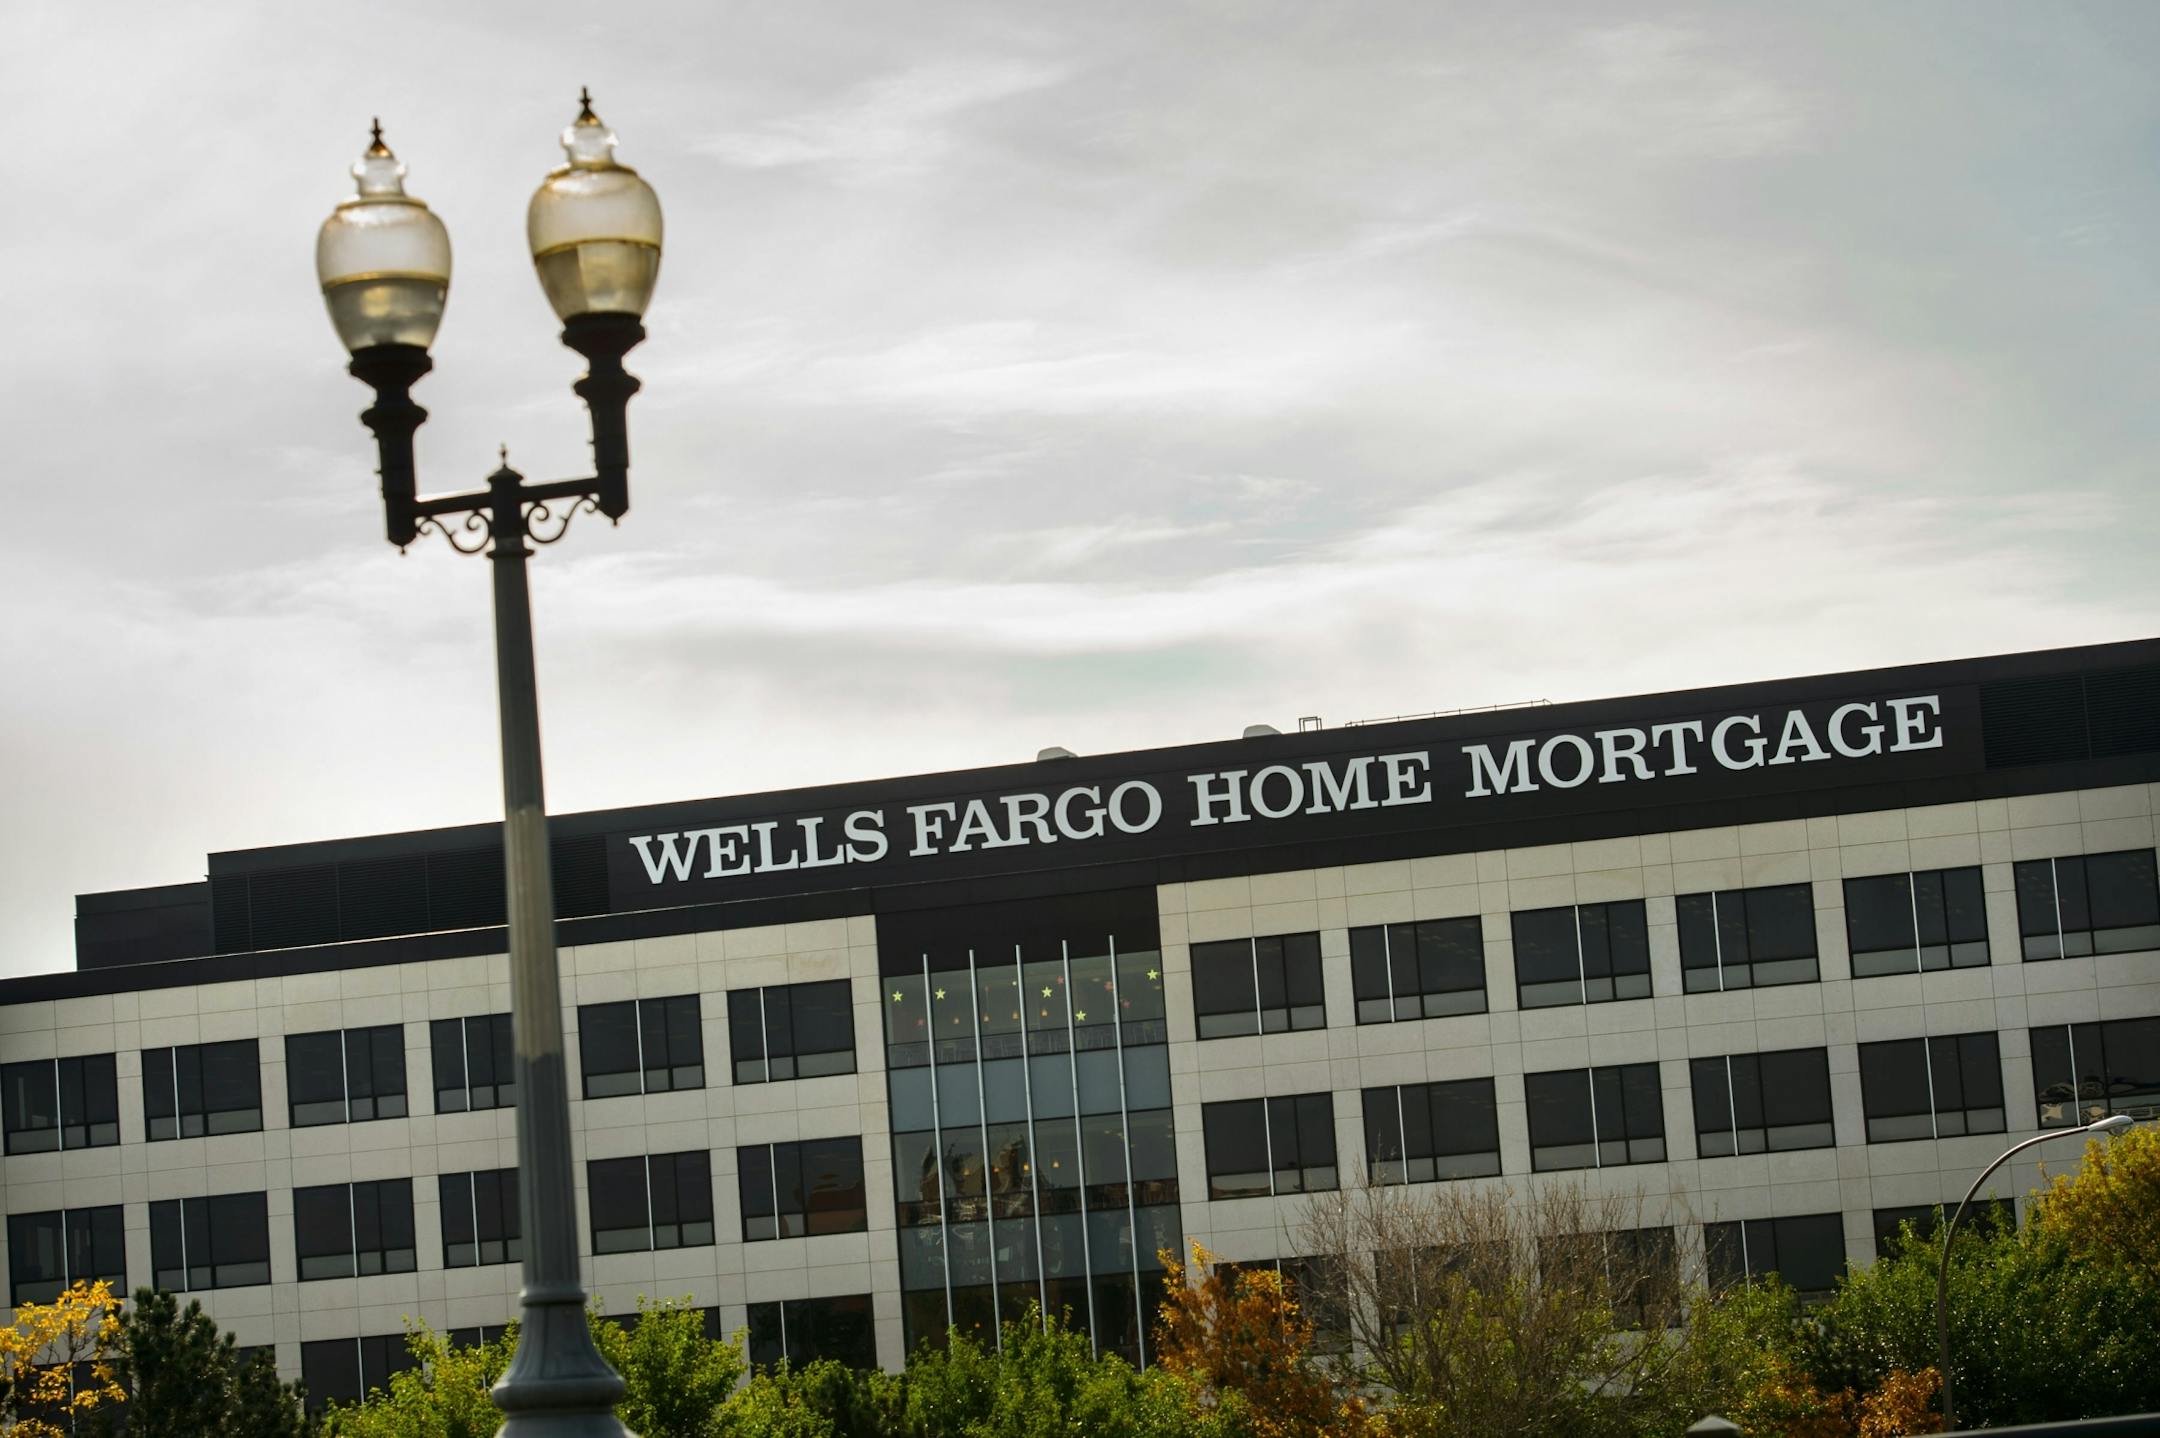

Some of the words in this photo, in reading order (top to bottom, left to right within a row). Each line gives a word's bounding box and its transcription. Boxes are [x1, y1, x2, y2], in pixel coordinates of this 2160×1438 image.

[628, 809, 888, 885] WELLS
[906, 780, 1163, 857] FARGO
[1187, 751, 1433, 827] HOME
[1461, 694, 1943, 798] MORTGAGE
